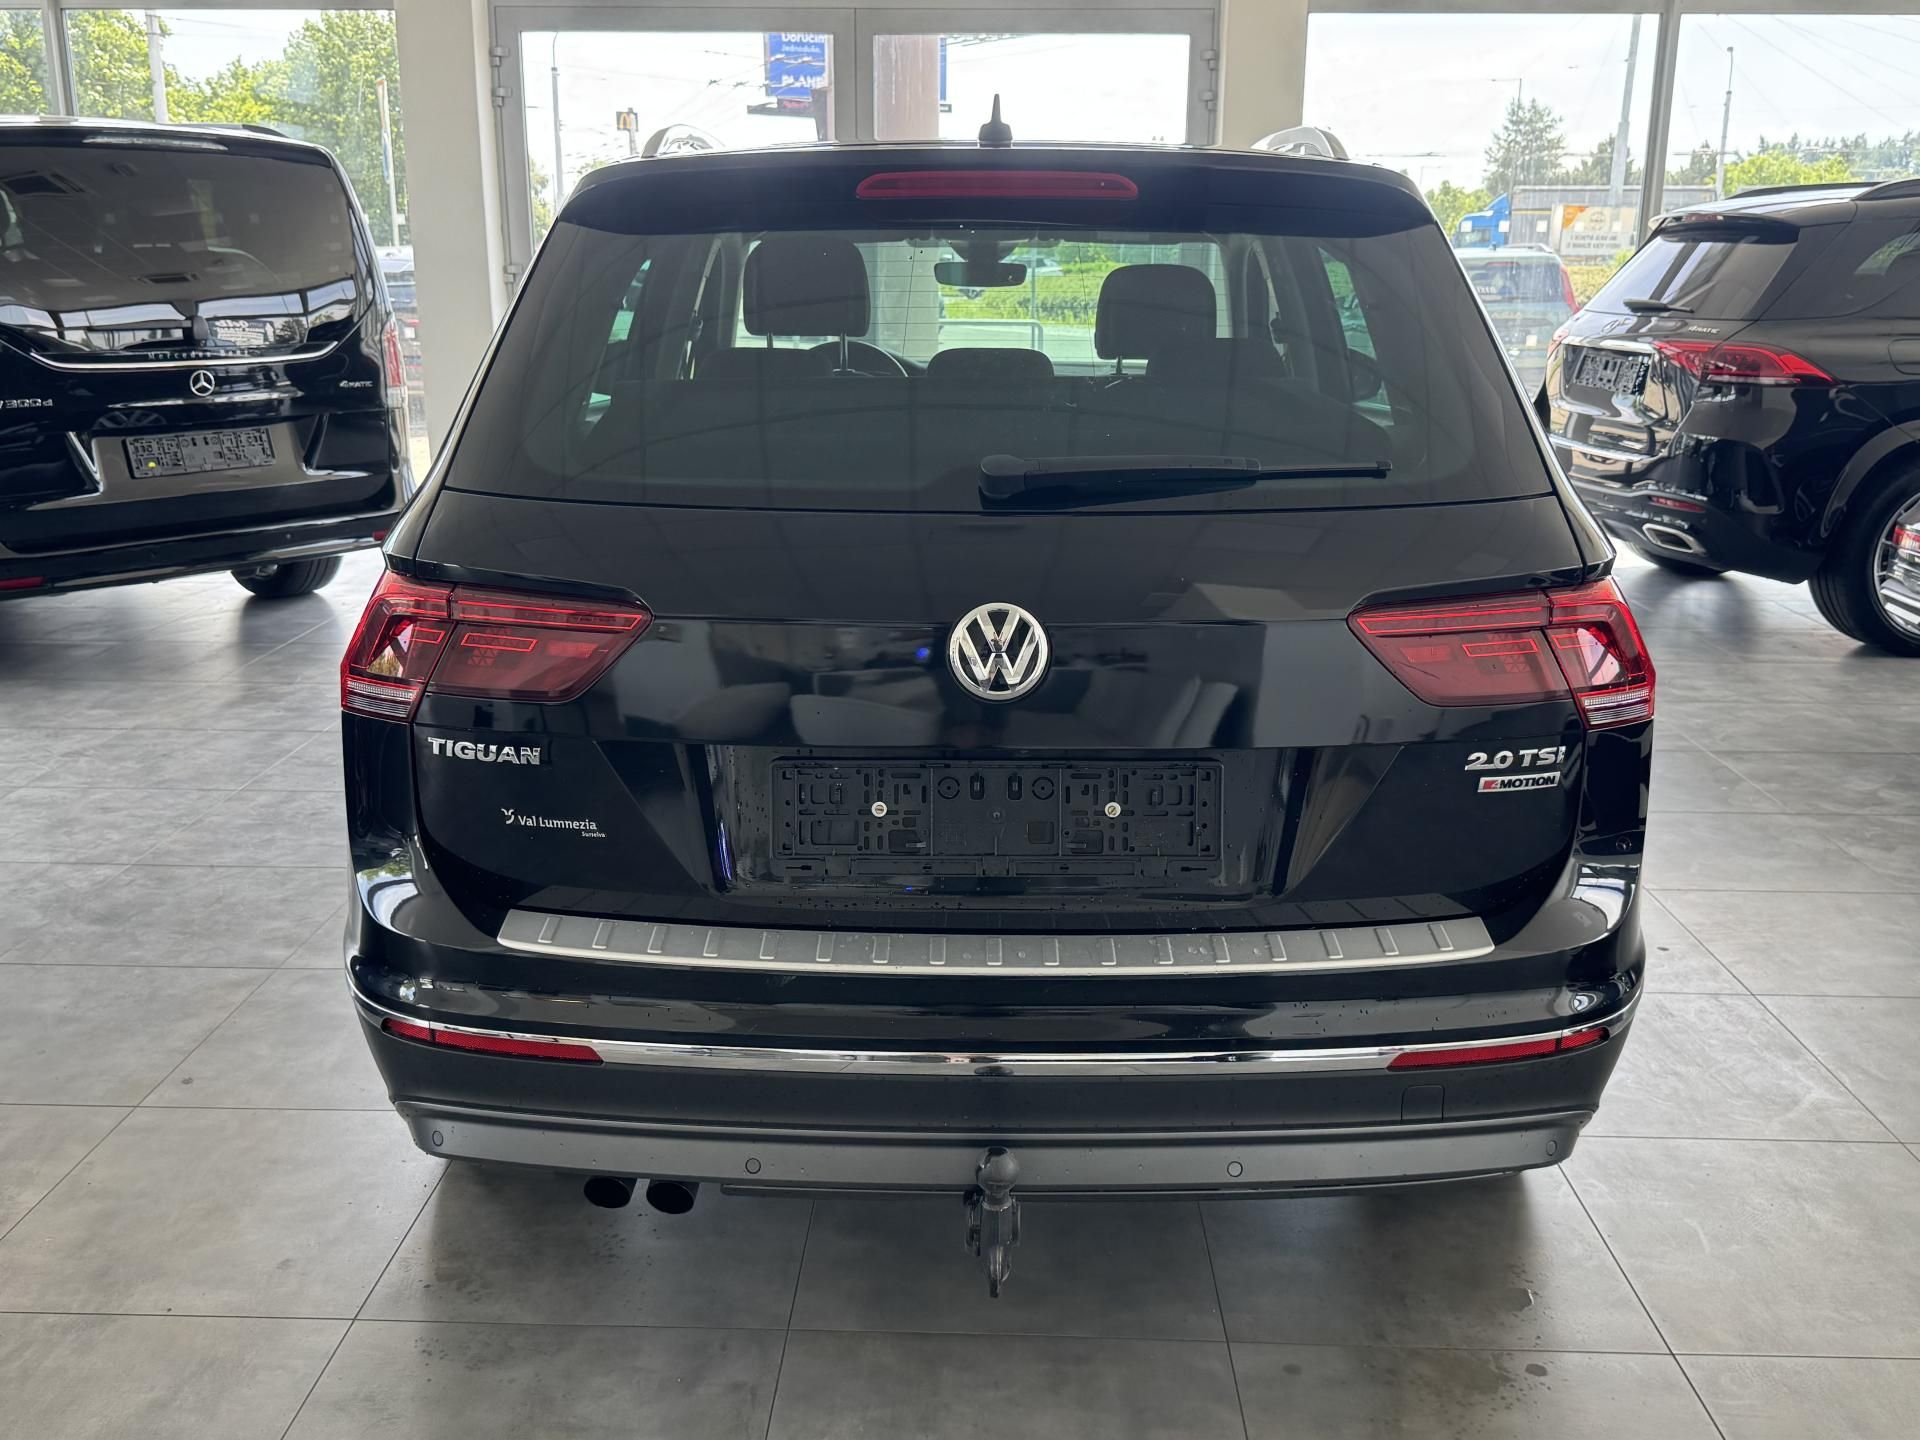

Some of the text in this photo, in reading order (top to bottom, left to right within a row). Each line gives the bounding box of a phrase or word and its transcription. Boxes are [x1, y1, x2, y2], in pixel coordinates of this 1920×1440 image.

[339, 380, 373, 388] 4MATIC
[427, 736, 541, 765] TIGUAN
[1518, 745, 1566, 767] TSI
[518, 815, 597, 830] Val Lumnezia
